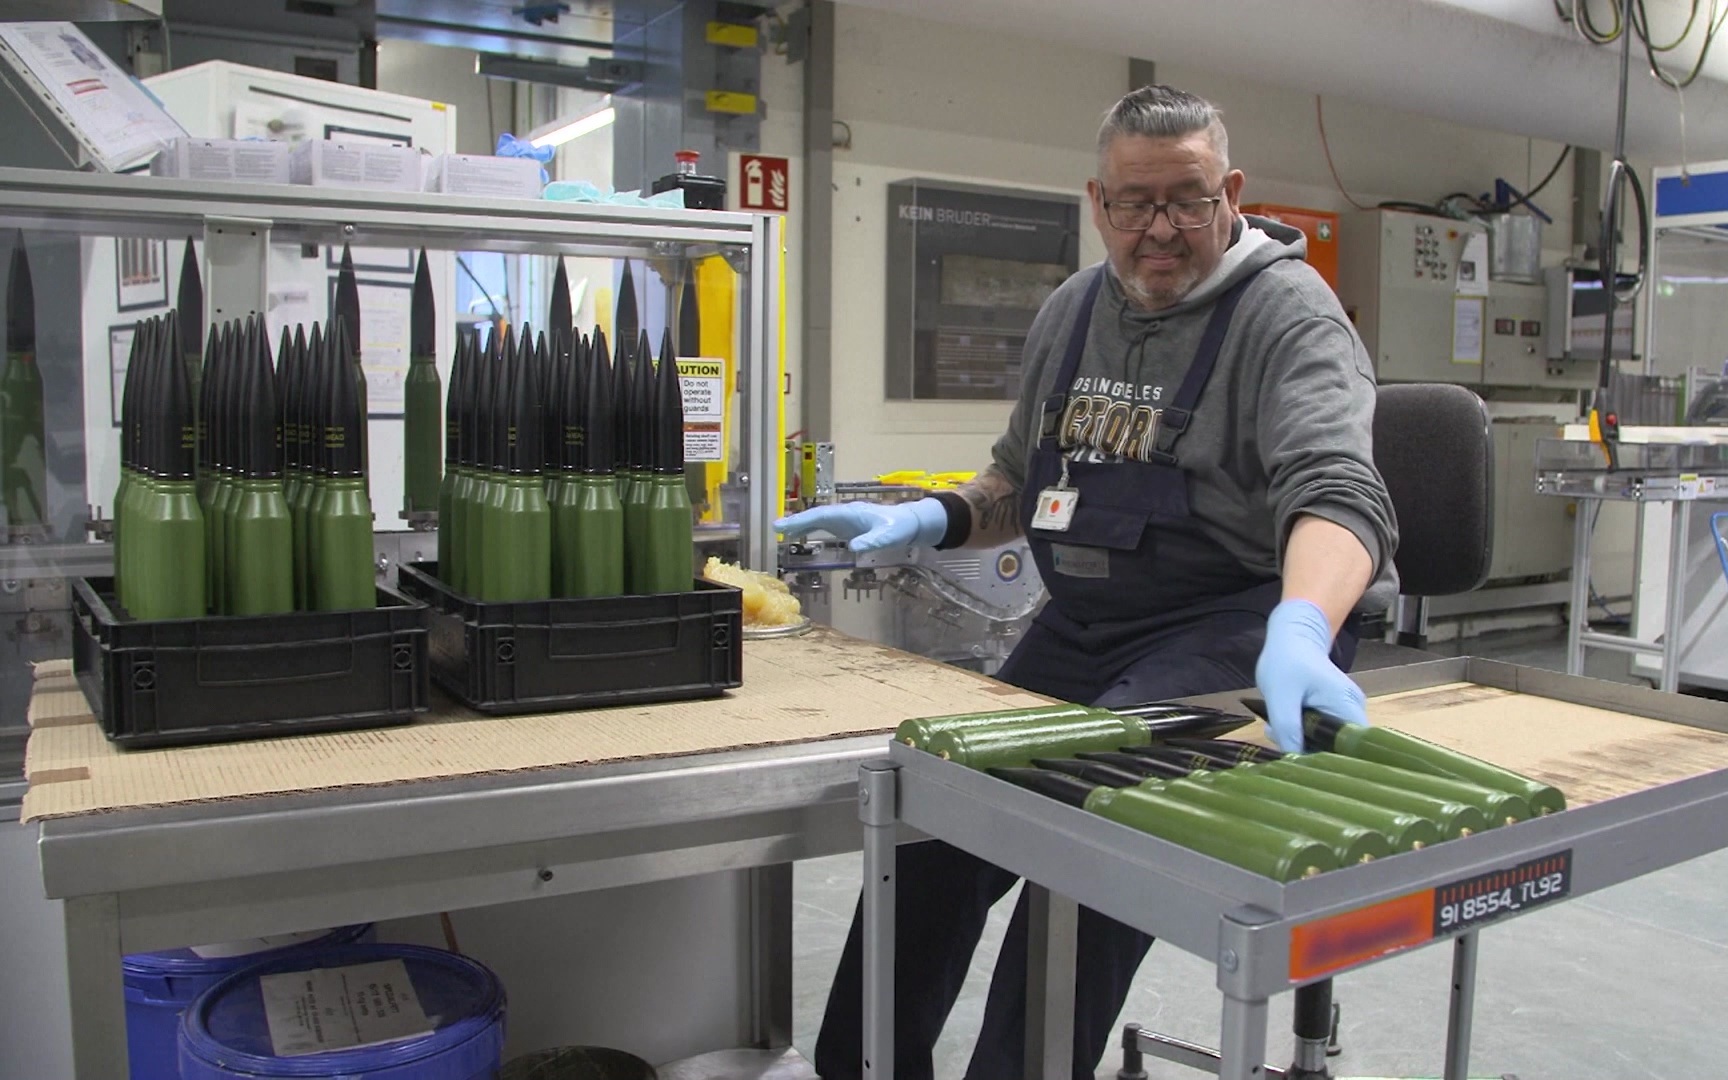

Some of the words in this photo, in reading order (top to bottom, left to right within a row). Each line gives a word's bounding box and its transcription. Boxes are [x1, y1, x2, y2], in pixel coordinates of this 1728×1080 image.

[899, 205, 933, 221] KEIN
[936, 208, 992, 227] BRUDER
[677, 365, 719, 375] UTION
[1073, 377, 1091, 393] OS
[684, 405, 709, 413] guards
[1061, 396, 1162, 462] CTOR
